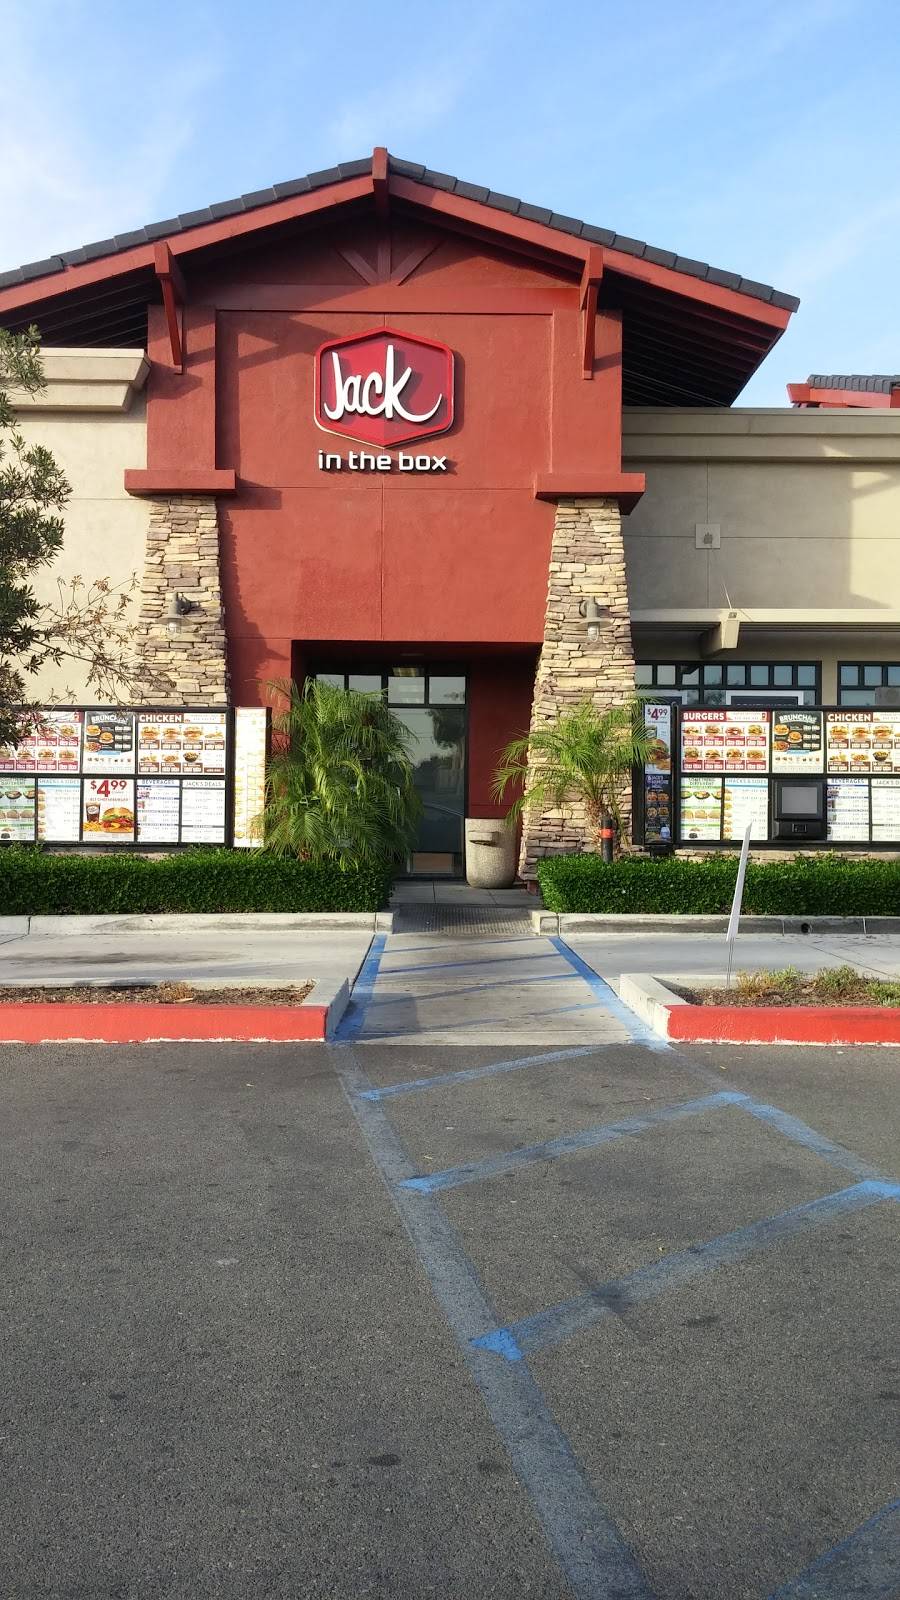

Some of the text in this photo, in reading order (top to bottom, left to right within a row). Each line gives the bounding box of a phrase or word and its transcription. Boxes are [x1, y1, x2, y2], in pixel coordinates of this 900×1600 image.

[324, 344, 443, 423] Jack
[318, 450, 447, 471] in the box
[139, 714, 182, 723] CHICKEN
[683, 712, 725, 720] BURGERS
[827, 713, 871, 722] CHICKEN
